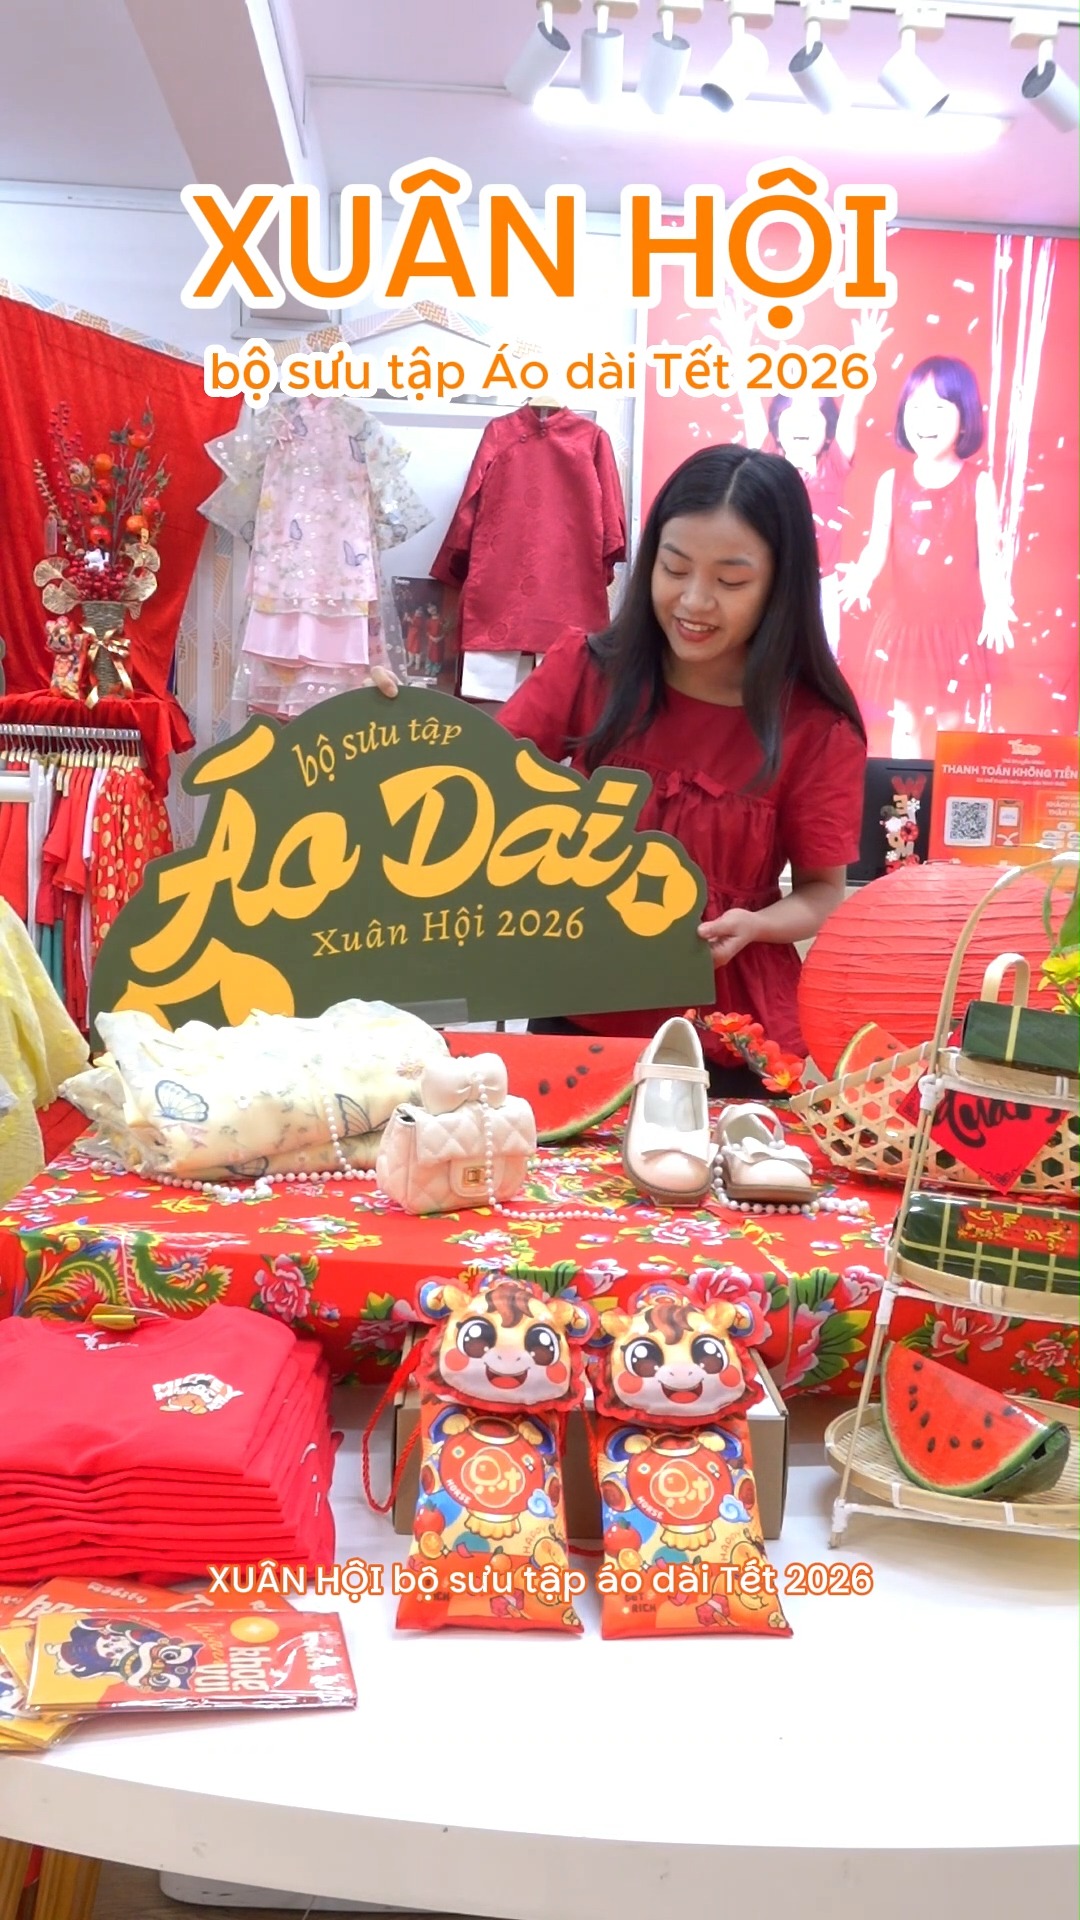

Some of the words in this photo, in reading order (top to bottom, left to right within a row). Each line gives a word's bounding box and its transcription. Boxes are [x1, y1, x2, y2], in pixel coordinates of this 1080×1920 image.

[292, 733, 335, 787] bộ
[342, 721, 401, 760] sưu
[408, 717, 462, 745] tập
[942, 764, 980, 776] THANH
[130, 724, 361, 973] Áo
[379, 749, 637, 898] Dài
[311, 920, 408, 957] Xuân
[422, 907, 485, 946] Hội
[497, 907, 584, 940] 2026
[446, 1478, 472, 1505] HORSE
[637, 1496, 665, 1520] HORSE
